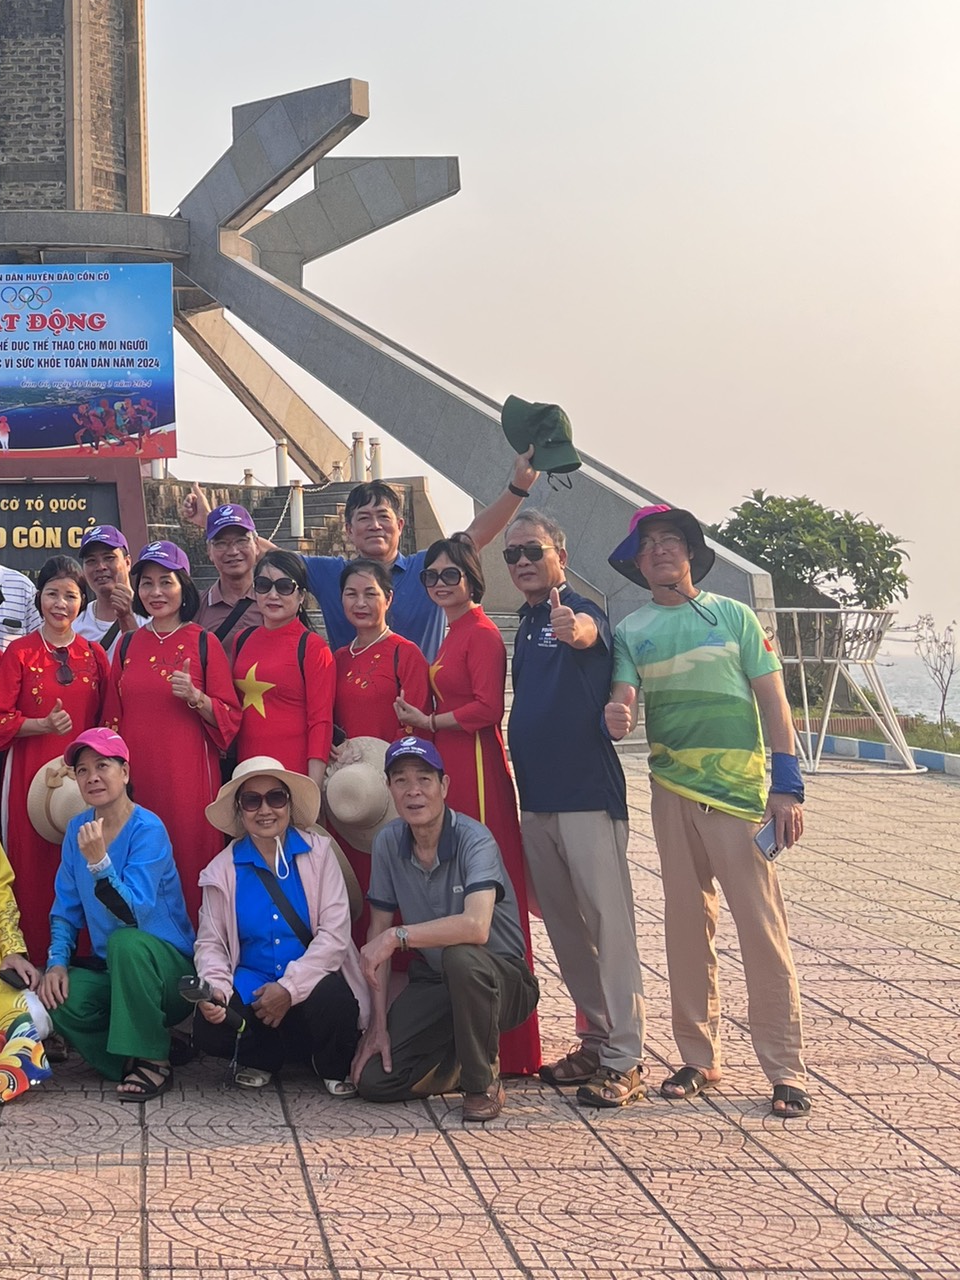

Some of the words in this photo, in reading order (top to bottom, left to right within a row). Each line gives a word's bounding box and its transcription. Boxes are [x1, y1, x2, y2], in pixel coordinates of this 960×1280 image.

[5, 272, 24, 282] DÂN
[26, 271, 54, 283] HUYỆN
[26, 308, 107, 336] ĐỘNG
[11, 340, 30, 353] DỤC
[52, 340, 75, 351] THAO
[78, 340, 96, 351] CHO
[99, 340, 117, 353] MỌI
[119, 338, 148, 351] NGƯỜI
[4, 356, 13, 369] VÌ
[16, 356, 35, 369] SỨC
[37, 355, 61, 368] KHỎE
[64, 356, 88, 368] TOÀN
[91, 356, 110, 368] DÂN
[112, 356, 135, 368] NĂM
[137, 358, 160, 369] 2024
[0, 496, 20, 511] CỜ
[49, 494, 87, 513] QUỐC
